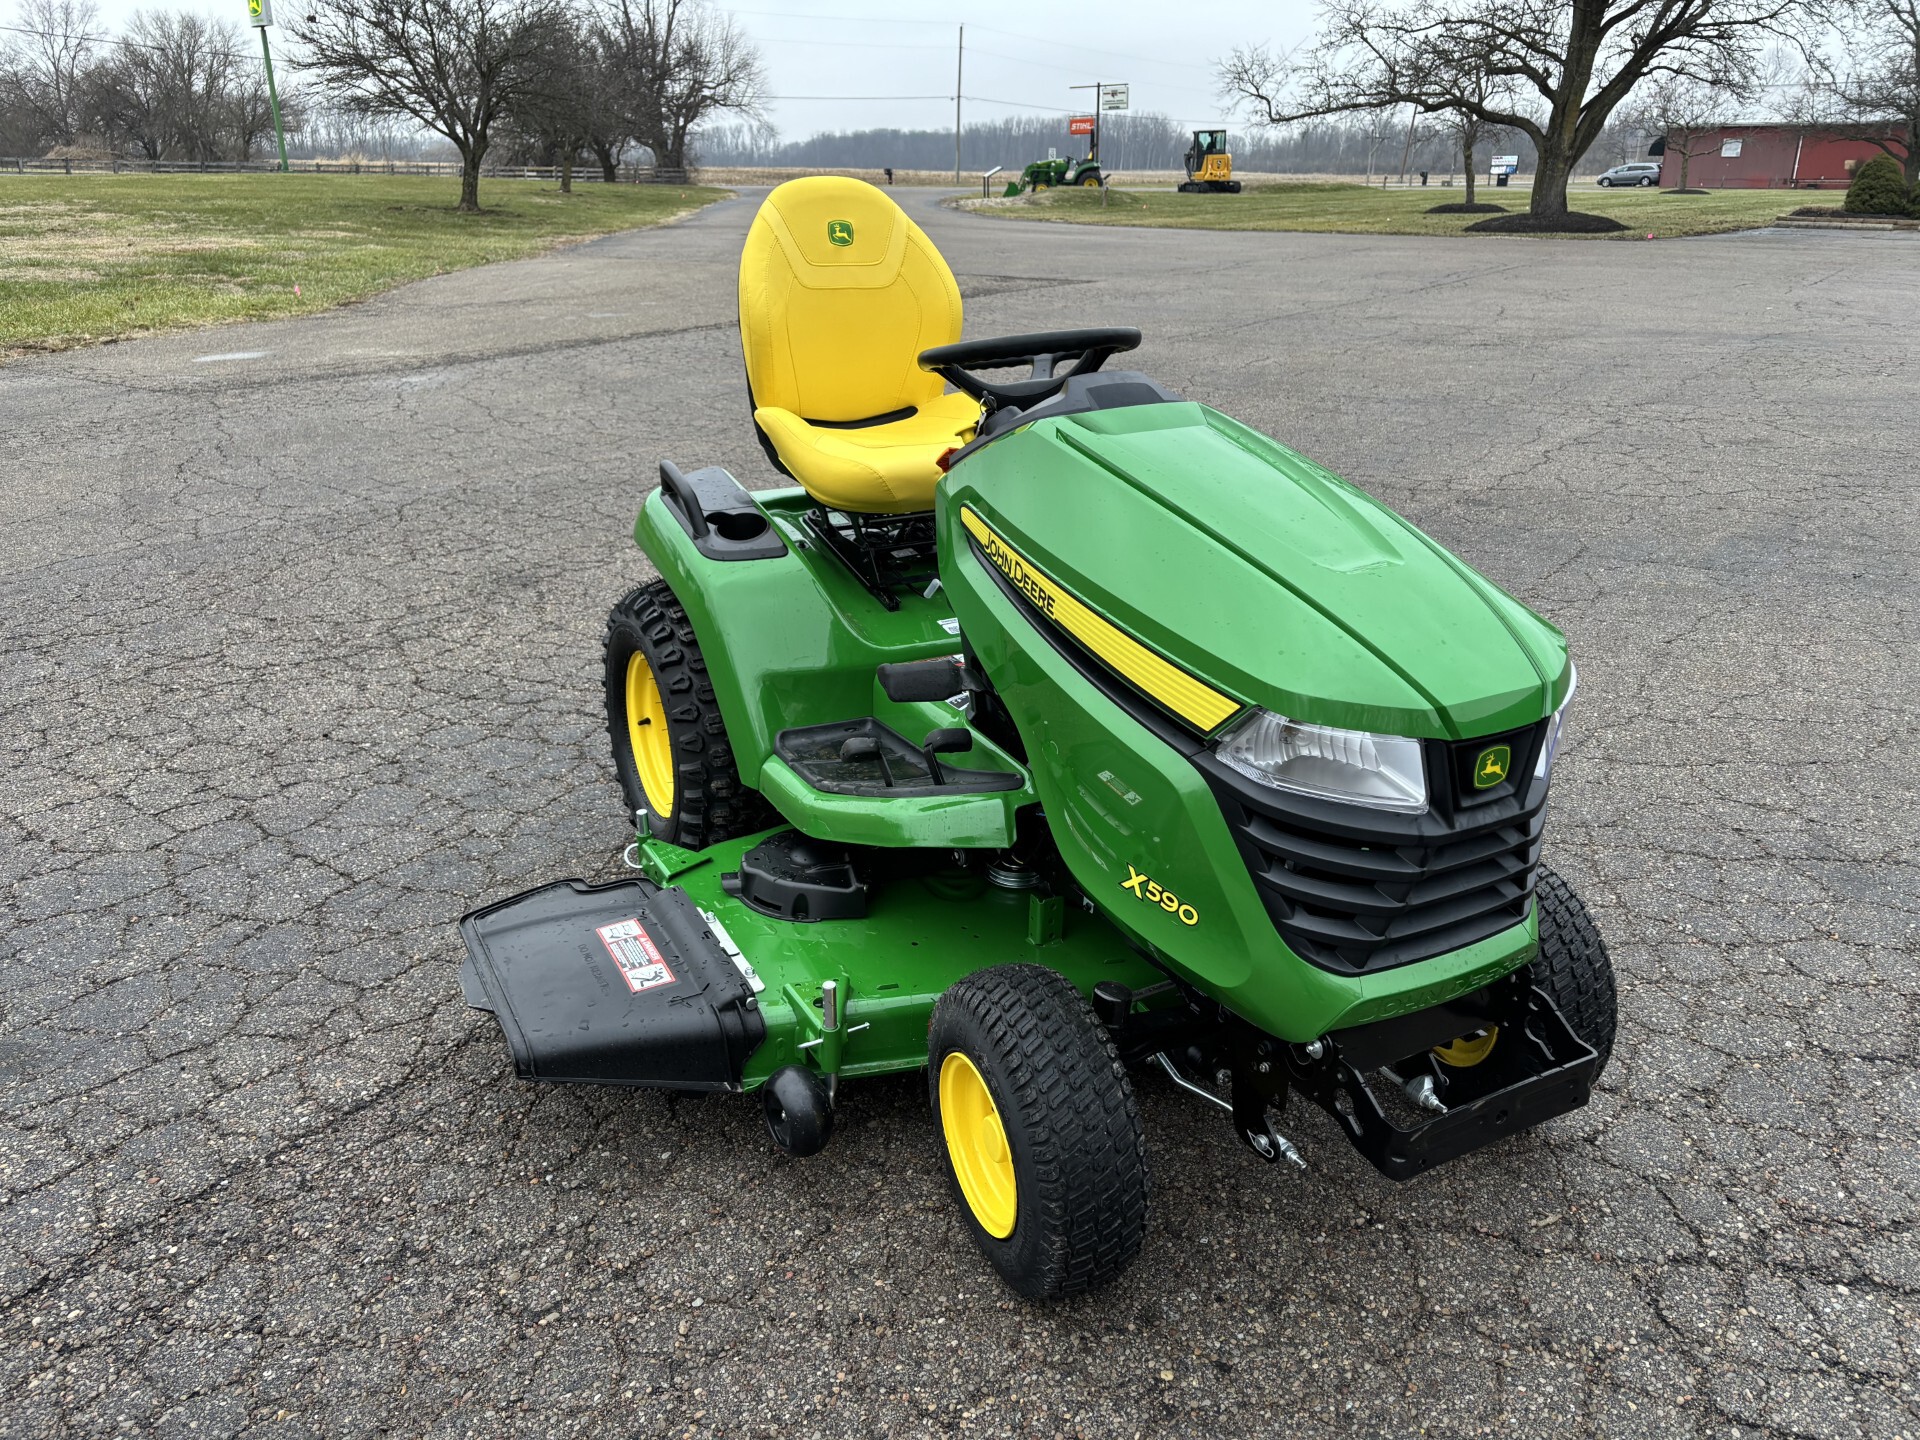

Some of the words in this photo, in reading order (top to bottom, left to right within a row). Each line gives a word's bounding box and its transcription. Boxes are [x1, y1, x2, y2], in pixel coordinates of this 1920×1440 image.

[1071, 122, 1095, 131] STIHL
[983, 532, 1013, 576] JOHN
[1014, 560, 1056, 617] DEERE
[1118, 862, 1200, 926] X590
[641, 940, 661, 961] DANGER
